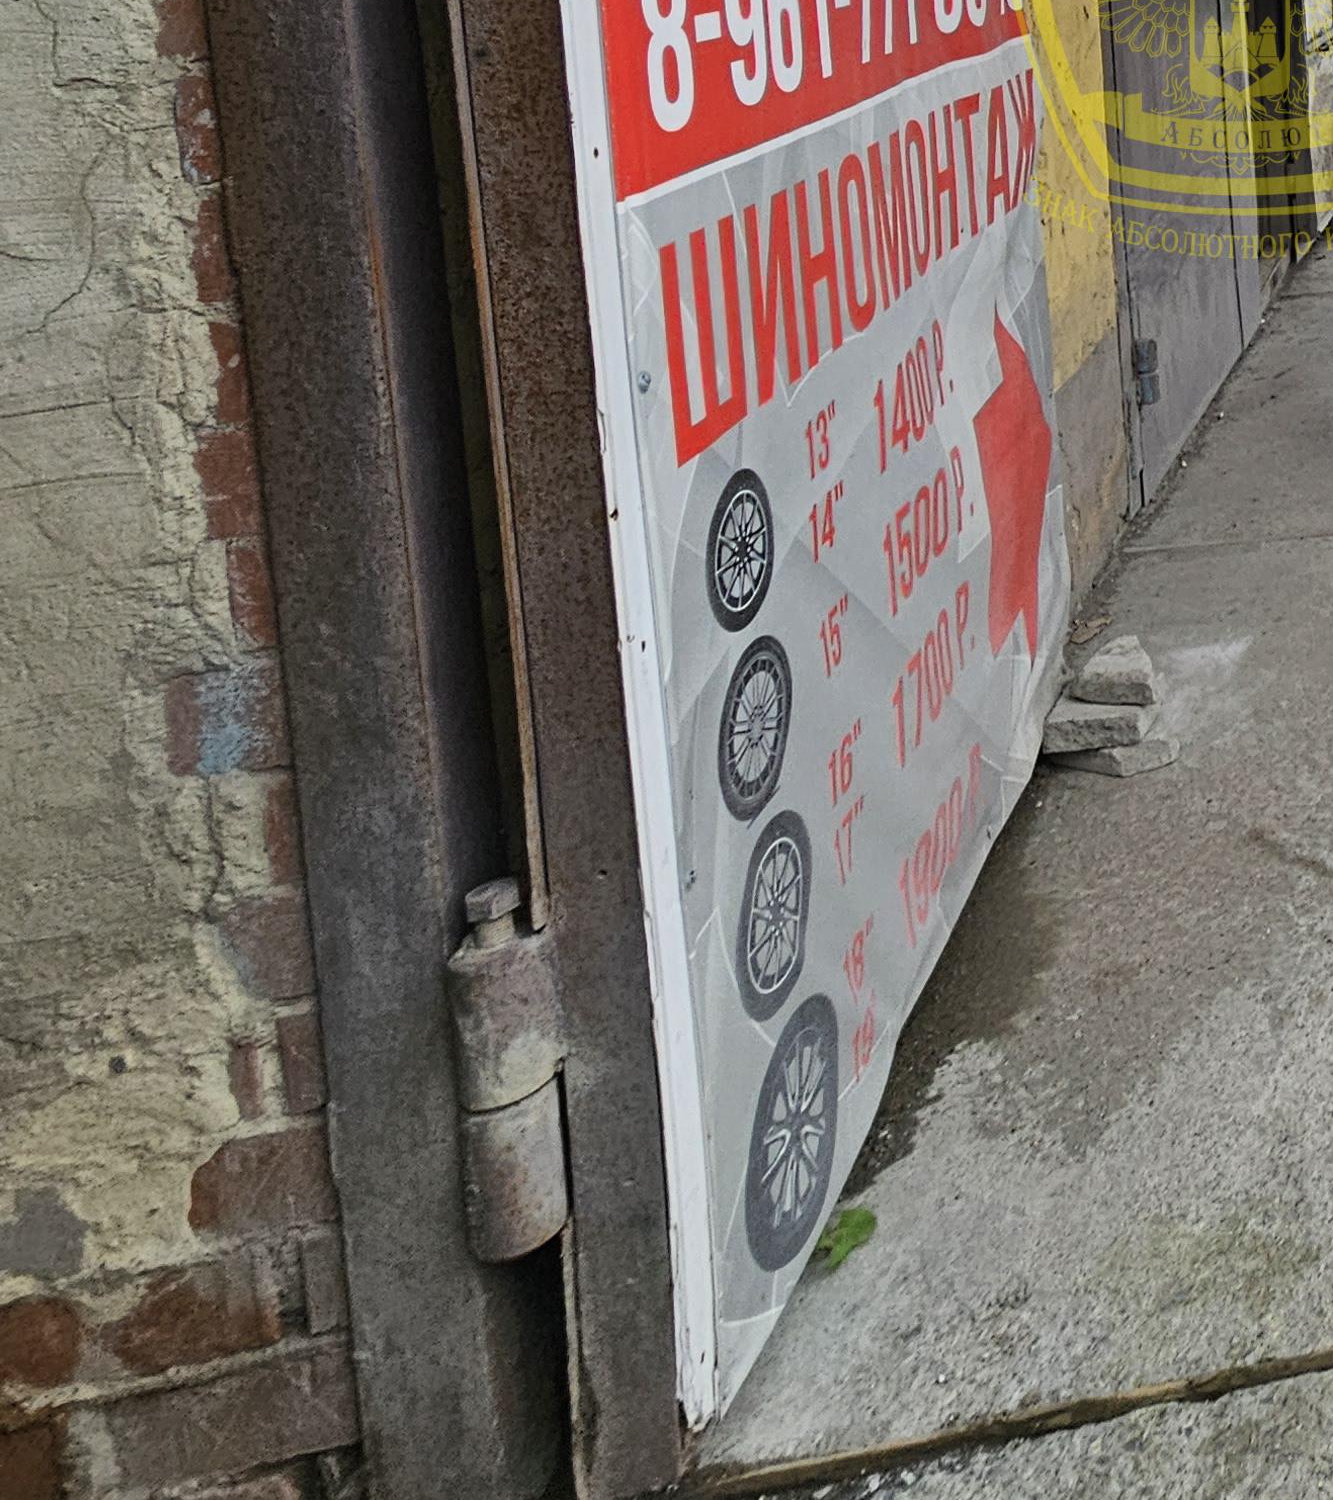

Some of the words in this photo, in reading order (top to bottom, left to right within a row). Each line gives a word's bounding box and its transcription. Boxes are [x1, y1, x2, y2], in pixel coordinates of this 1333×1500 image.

[659, 69, 1036, 468] ШИНОМОНТАЖ
[874, 336, 934, 474] 1400
[884, 468, 948, 617] 1500
[892, 609, 952, 768] 1700
